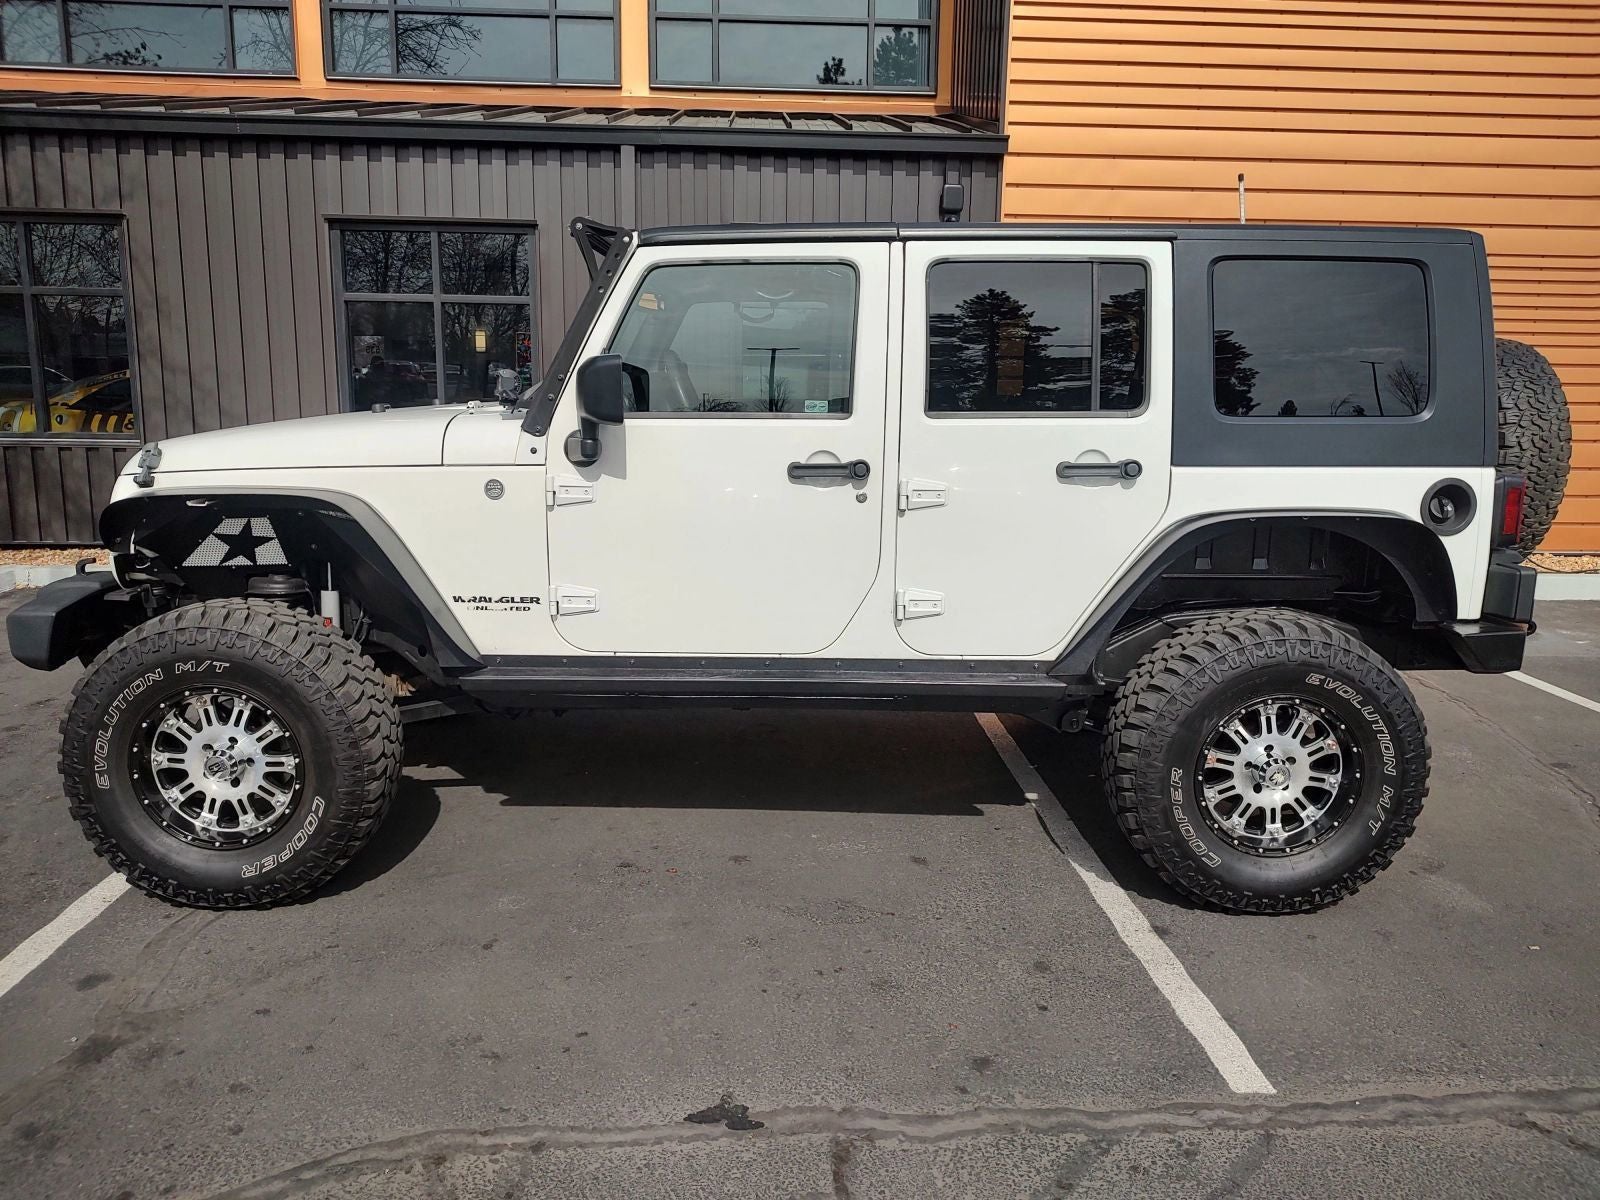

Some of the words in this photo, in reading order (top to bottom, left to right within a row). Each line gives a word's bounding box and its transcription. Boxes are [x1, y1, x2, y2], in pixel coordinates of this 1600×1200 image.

[94, 668, 164, 789] EVOLUTION
[175, 660, 230, 674] M/T
[1305, 672, 1397, 776] EVOLUTION
[1368, 784, 1394, 836] M/T
[241, 796, 325, 878] COOPER
[1170, 767, 1222, 868] COOPER
